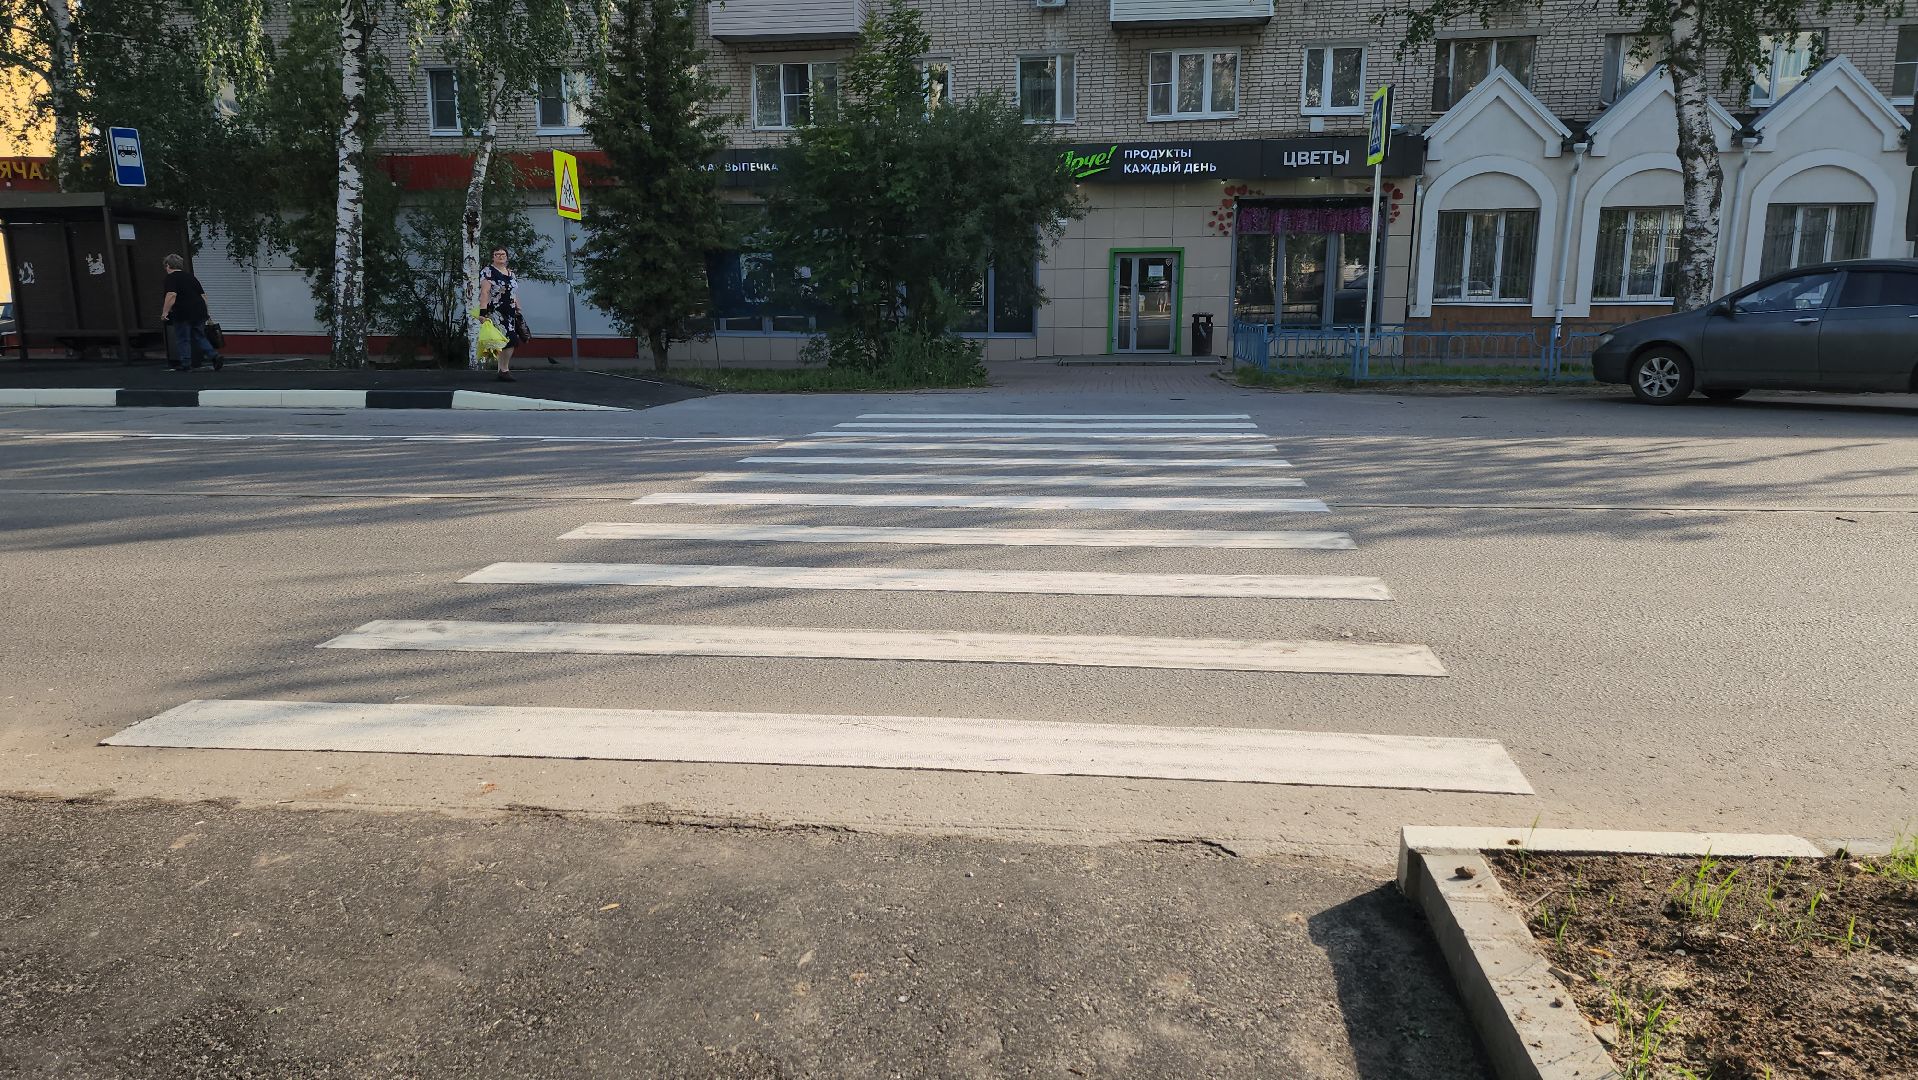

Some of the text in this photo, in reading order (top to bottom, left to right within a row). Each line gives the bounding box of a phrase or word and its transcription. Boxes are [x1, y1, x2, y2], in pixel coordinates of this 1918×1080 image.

[1124, 149, 1191, 160] ПРОДУКТЫ
[1283, 150, 1350, 168] ЦВЕТЫ
[725, 162, 779, 172] ВЫПЕЧКА
[1123, 161, 1217, 174] КАЖДЫЙ ДЕНЬ
